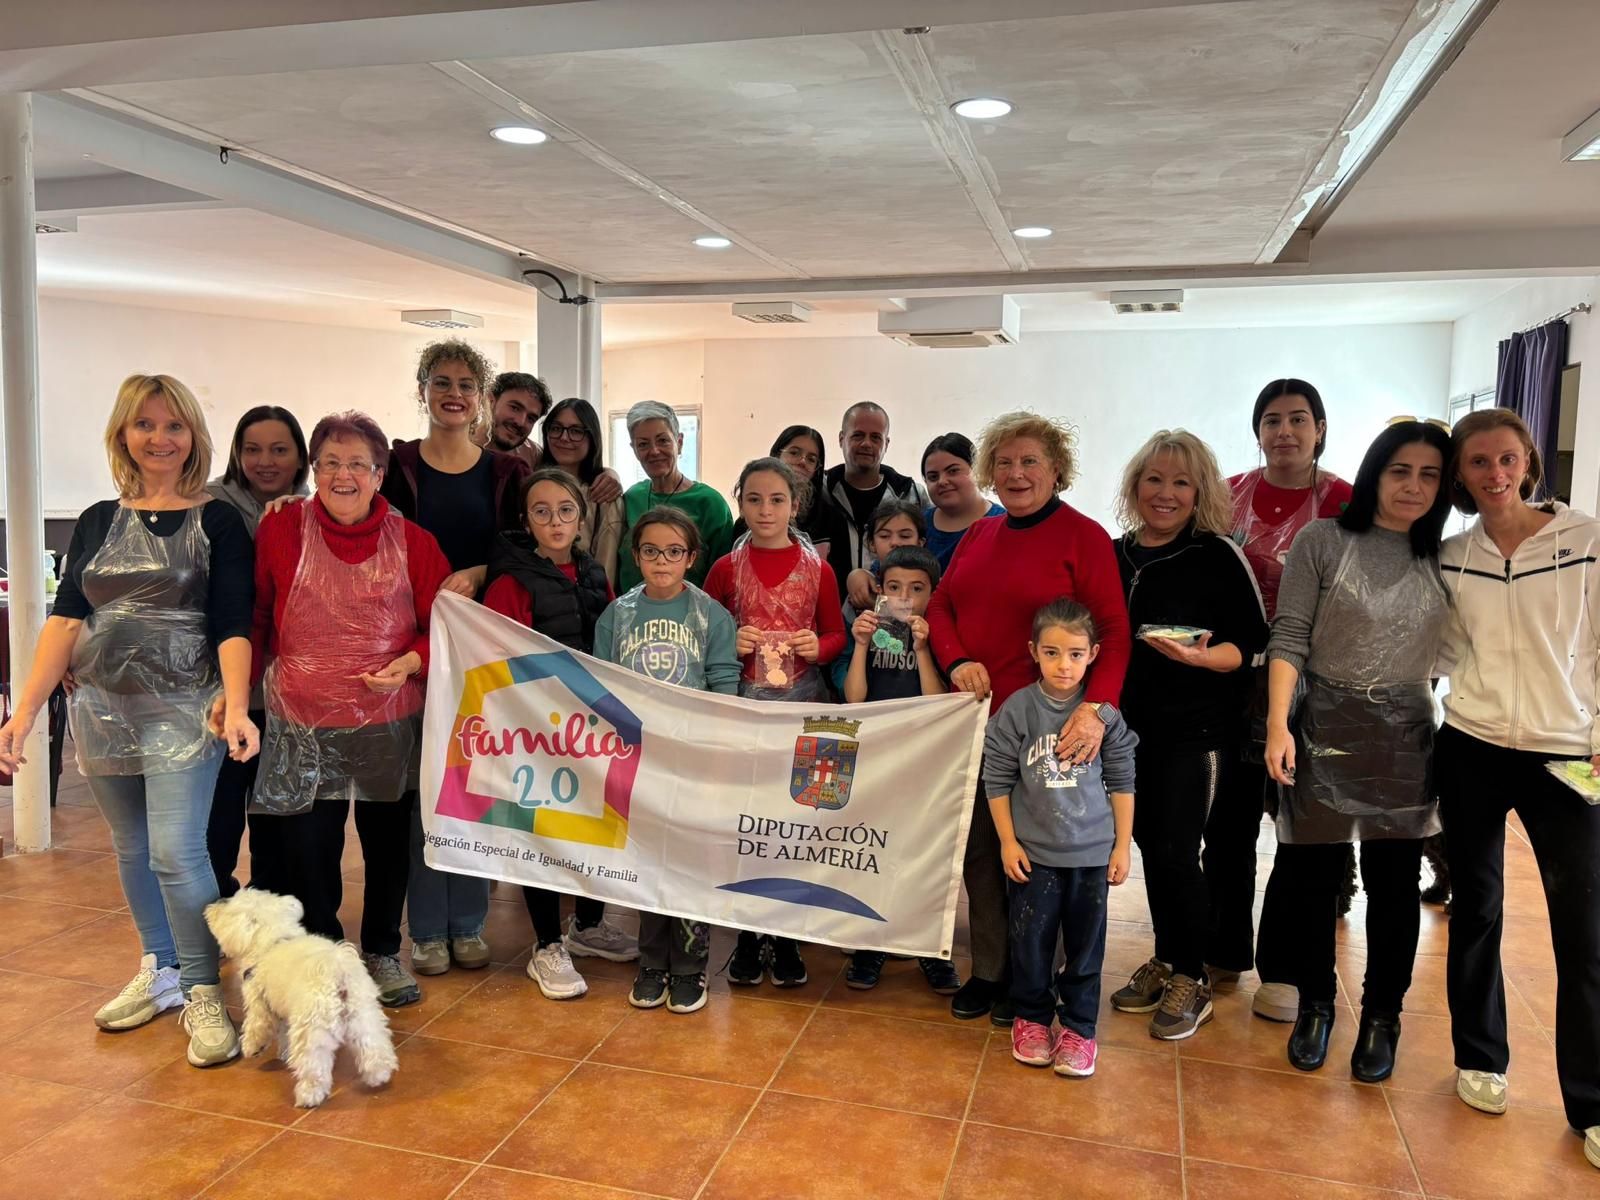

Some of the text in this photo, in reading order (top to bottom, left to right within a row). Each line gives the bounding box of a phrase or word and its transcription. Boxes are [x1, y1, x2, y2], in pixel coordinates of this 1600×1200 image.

[620, 619, 700, 663] CALIFORNIA
[648, 651, 673, 670] 95
[458, 712, 633, 759] familia
[1027, 733, 1061, 767] CALIF
[512, 765, 579, 808] 2.0
[737, 814, 889, 848] DIPUTACIÓN
[473, 841, 519, 859] Especial
[522, 849, 536, 862] de
[539, 853, 585, 873] Igualdad
[586, 866, 594, 877] y
[597, 865, 638, 883] Familia
[737, 838, 881, 874] DE ALMERÍA
